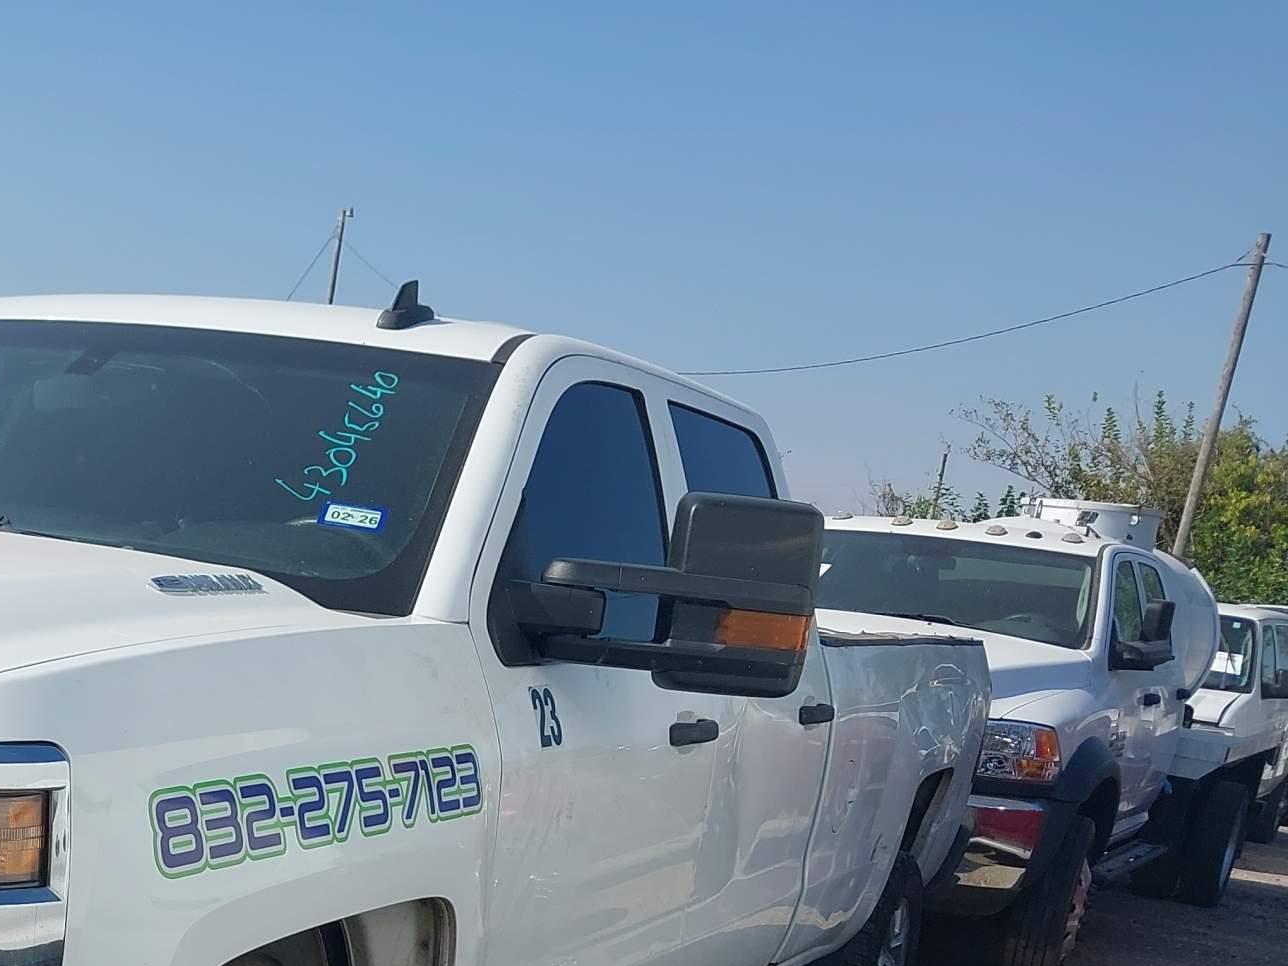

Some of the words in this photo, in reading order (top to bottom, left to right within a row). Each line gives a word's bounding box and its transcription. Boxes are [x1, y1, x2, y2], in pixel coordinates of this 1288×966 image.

[274, 370, 400, 502] 43045640
[528, 686, 563, 748] 23
[151, 746, 483, 876] 832-275-7123
